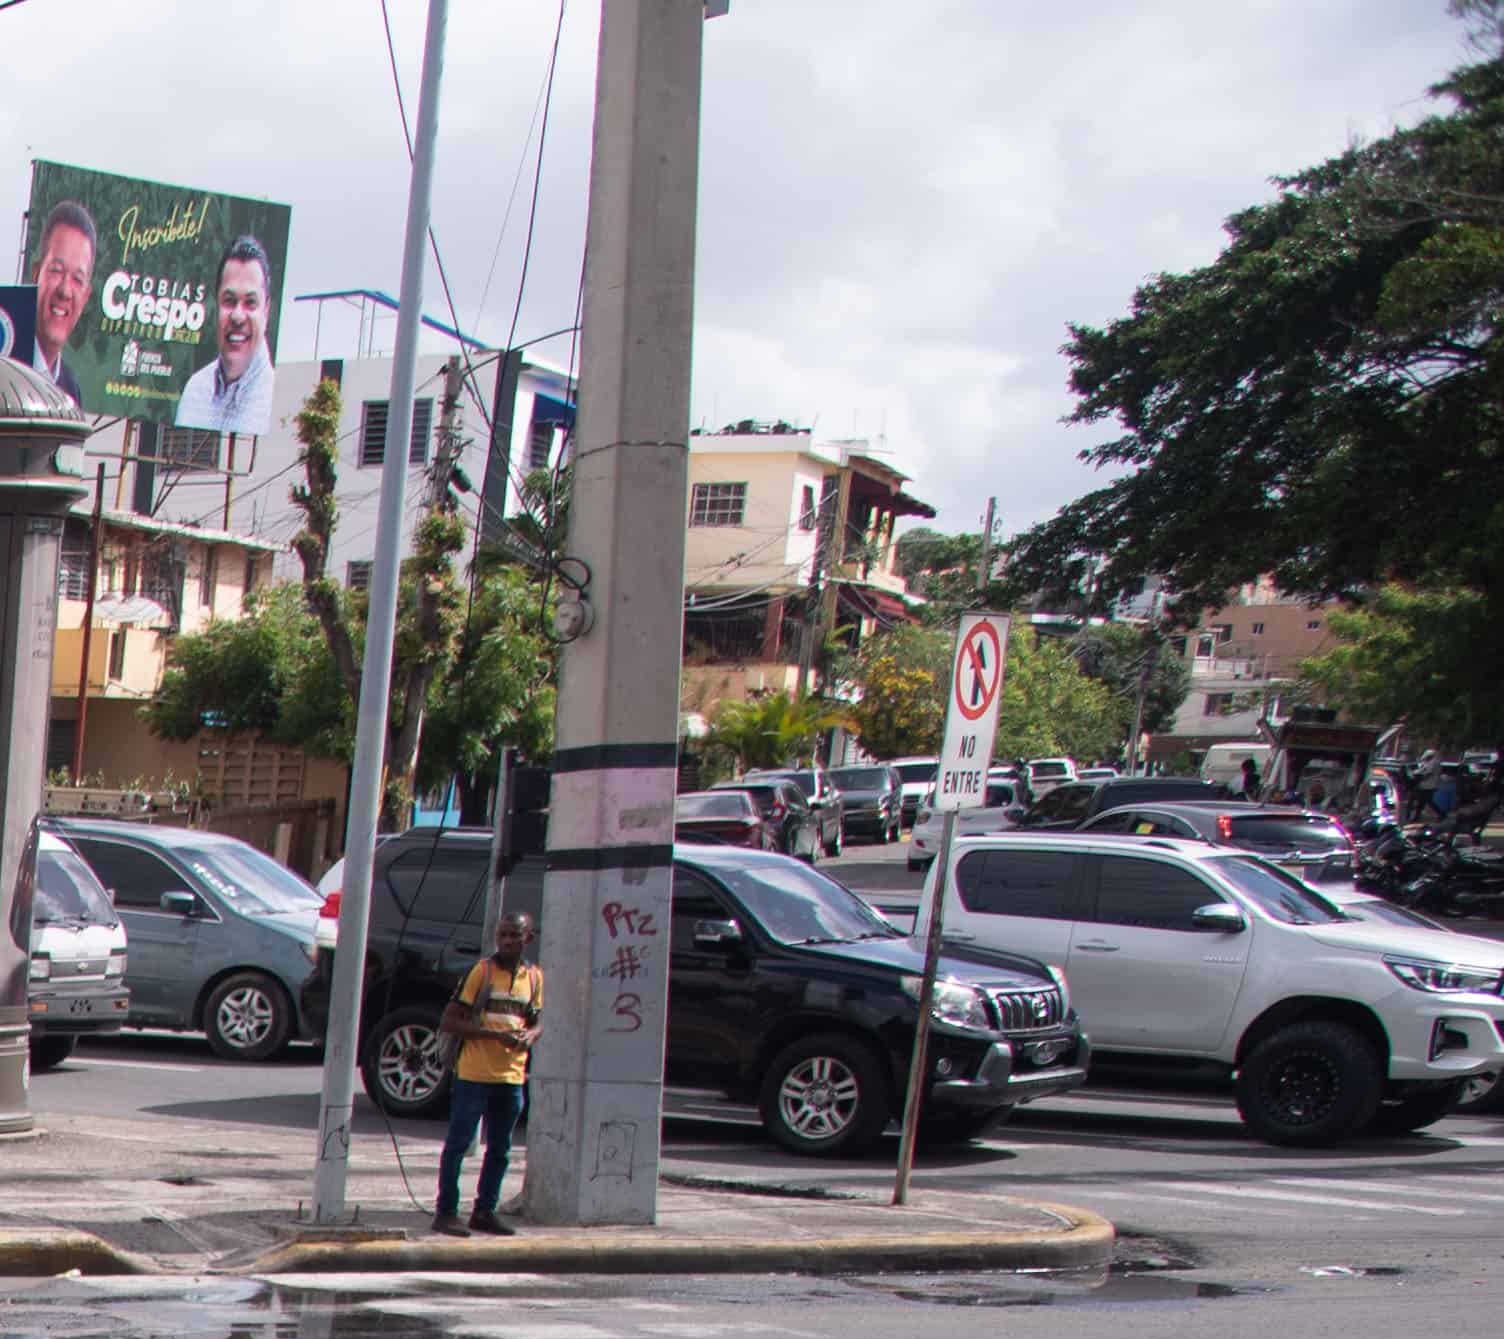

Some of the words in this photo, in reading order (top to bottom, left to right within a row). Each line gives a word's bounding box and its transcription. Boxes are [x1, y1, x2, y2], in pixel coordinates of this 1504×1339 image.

[130, 275, 205, 302] TOBIAS
[101, 271, 205, 341] Crespo
[959, 735, 976, 758] NO
[943, 770, 981, 794] ENTRE
